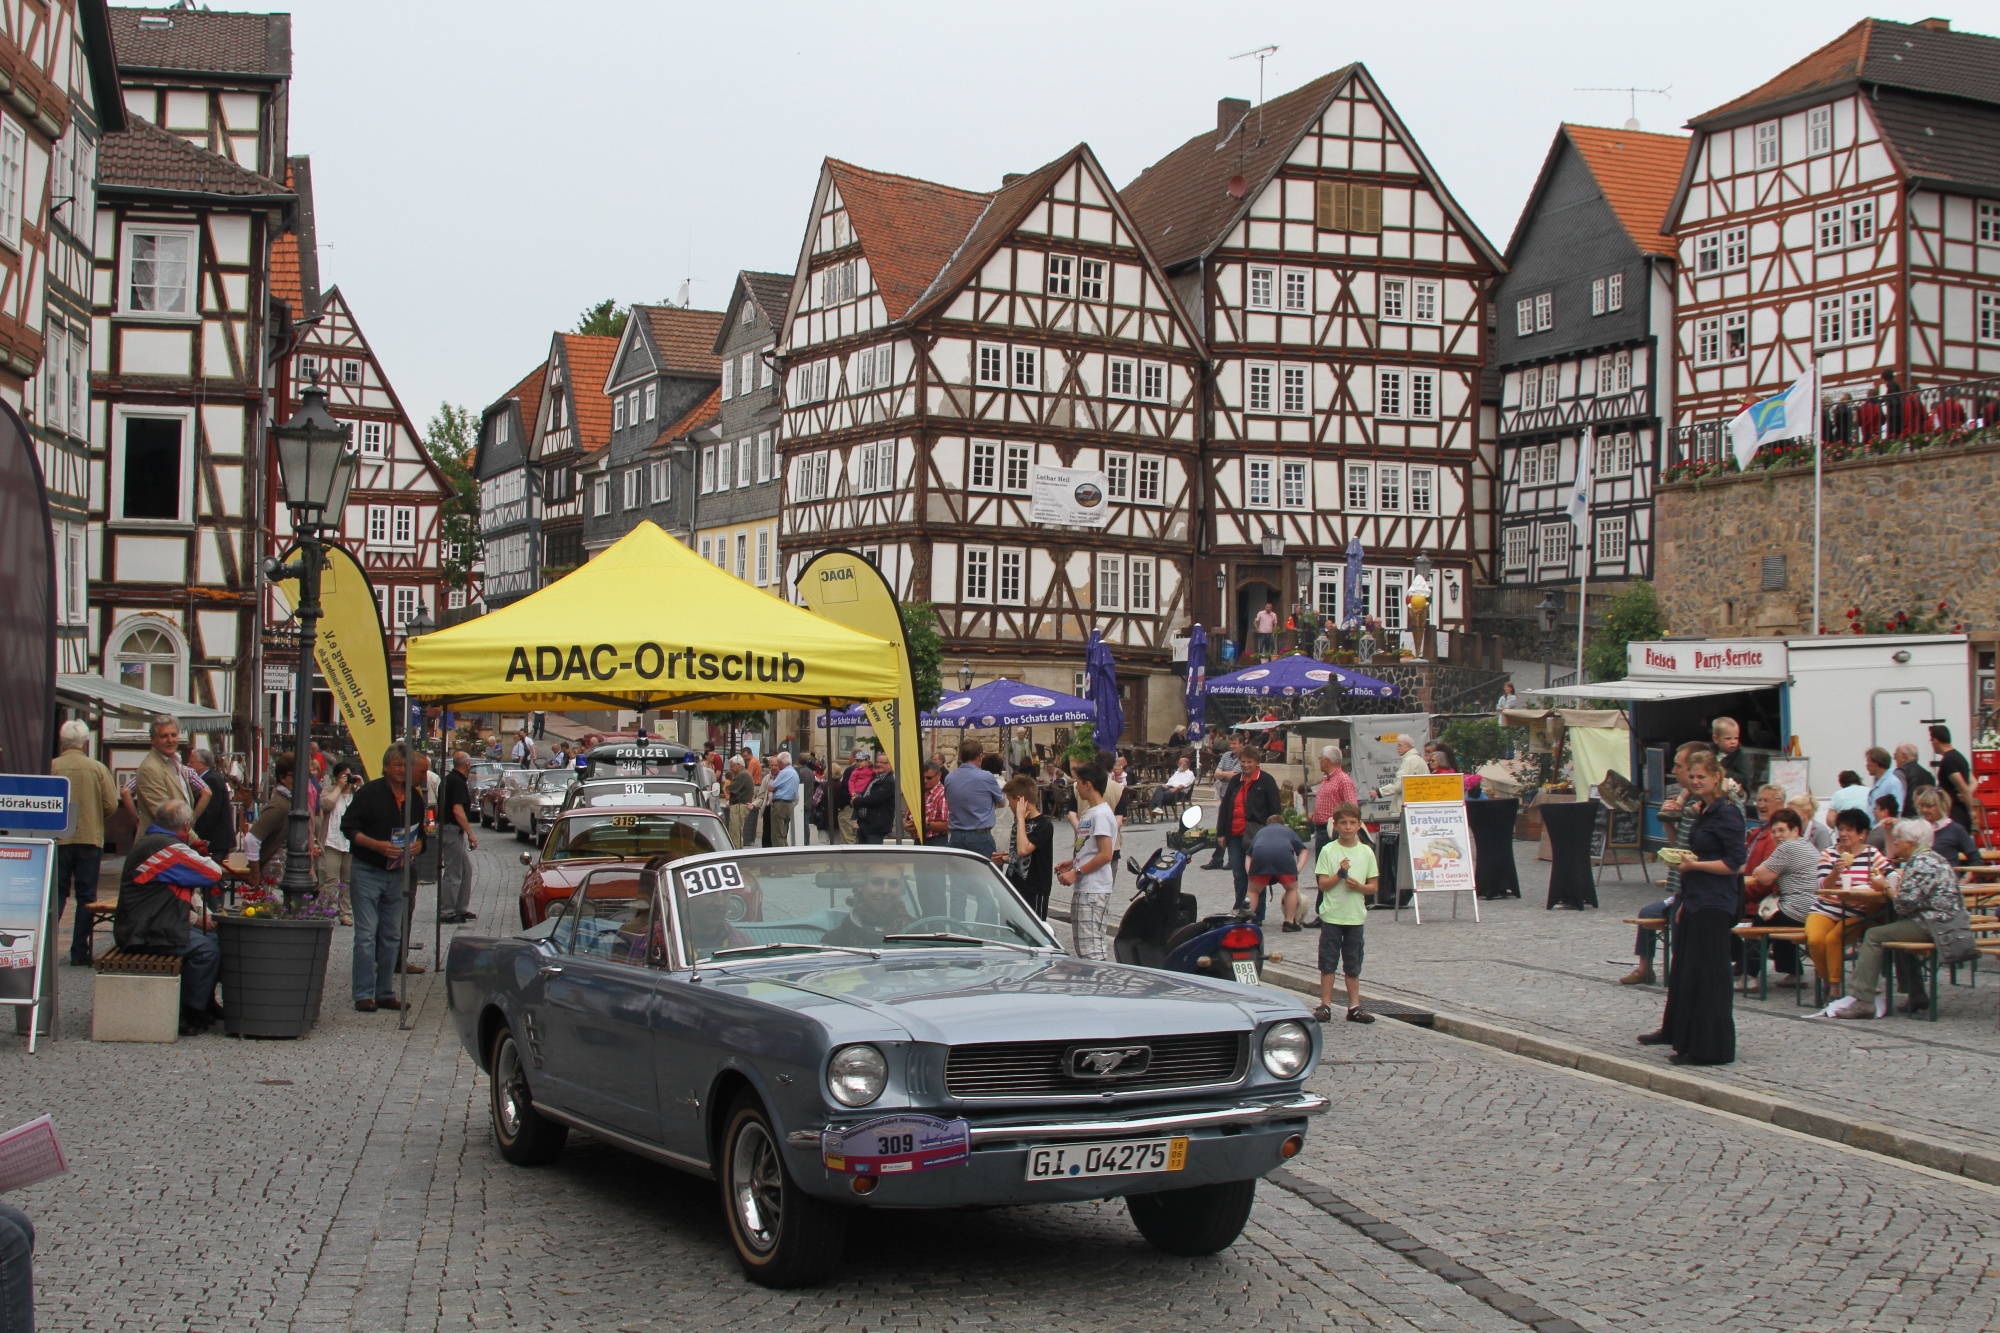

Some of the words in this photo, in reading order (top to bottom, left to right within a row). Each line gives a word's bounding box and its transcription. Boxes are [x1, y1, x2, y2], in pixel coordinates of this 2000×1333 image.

[505, 641, 806, 684] ADAC-Ortsclub
[1645, 648, 1676, 670] Fleisch
[1694, 648, 1763, 671] Party-Service
[920, 718, 933, 727] chatz
[1003, 716, 1016, 725] Der
[1020, 713, 1048, 724] Schatz
[1049, 713, 1064, 722] der
[1065, 711, 1089, 721] Rhön.
[616, 748, 669, 758] POLIZEI
[626, 784, 644, 794] 312
[613, 816, 636, 827] 319
[1410, 815, 1464, 826] Bratwurst
[683, 864, 741, 895] 309
[1234, 963, 1254, 974] 889
[900, 1116, 932, 1128] Hessentag
[932, 1121, 950, 1132] 2013
[878, 1134, 914, 1155] 309
[1173, 1141, 1184, 1150] 16
[827, 1154, 844, 1162] ADAC
[1033, 1149, 1065, 1176] GI
[1085, 1142, 1168, 1173] 04275
[1171, 1159, 1182, 1168] 13
